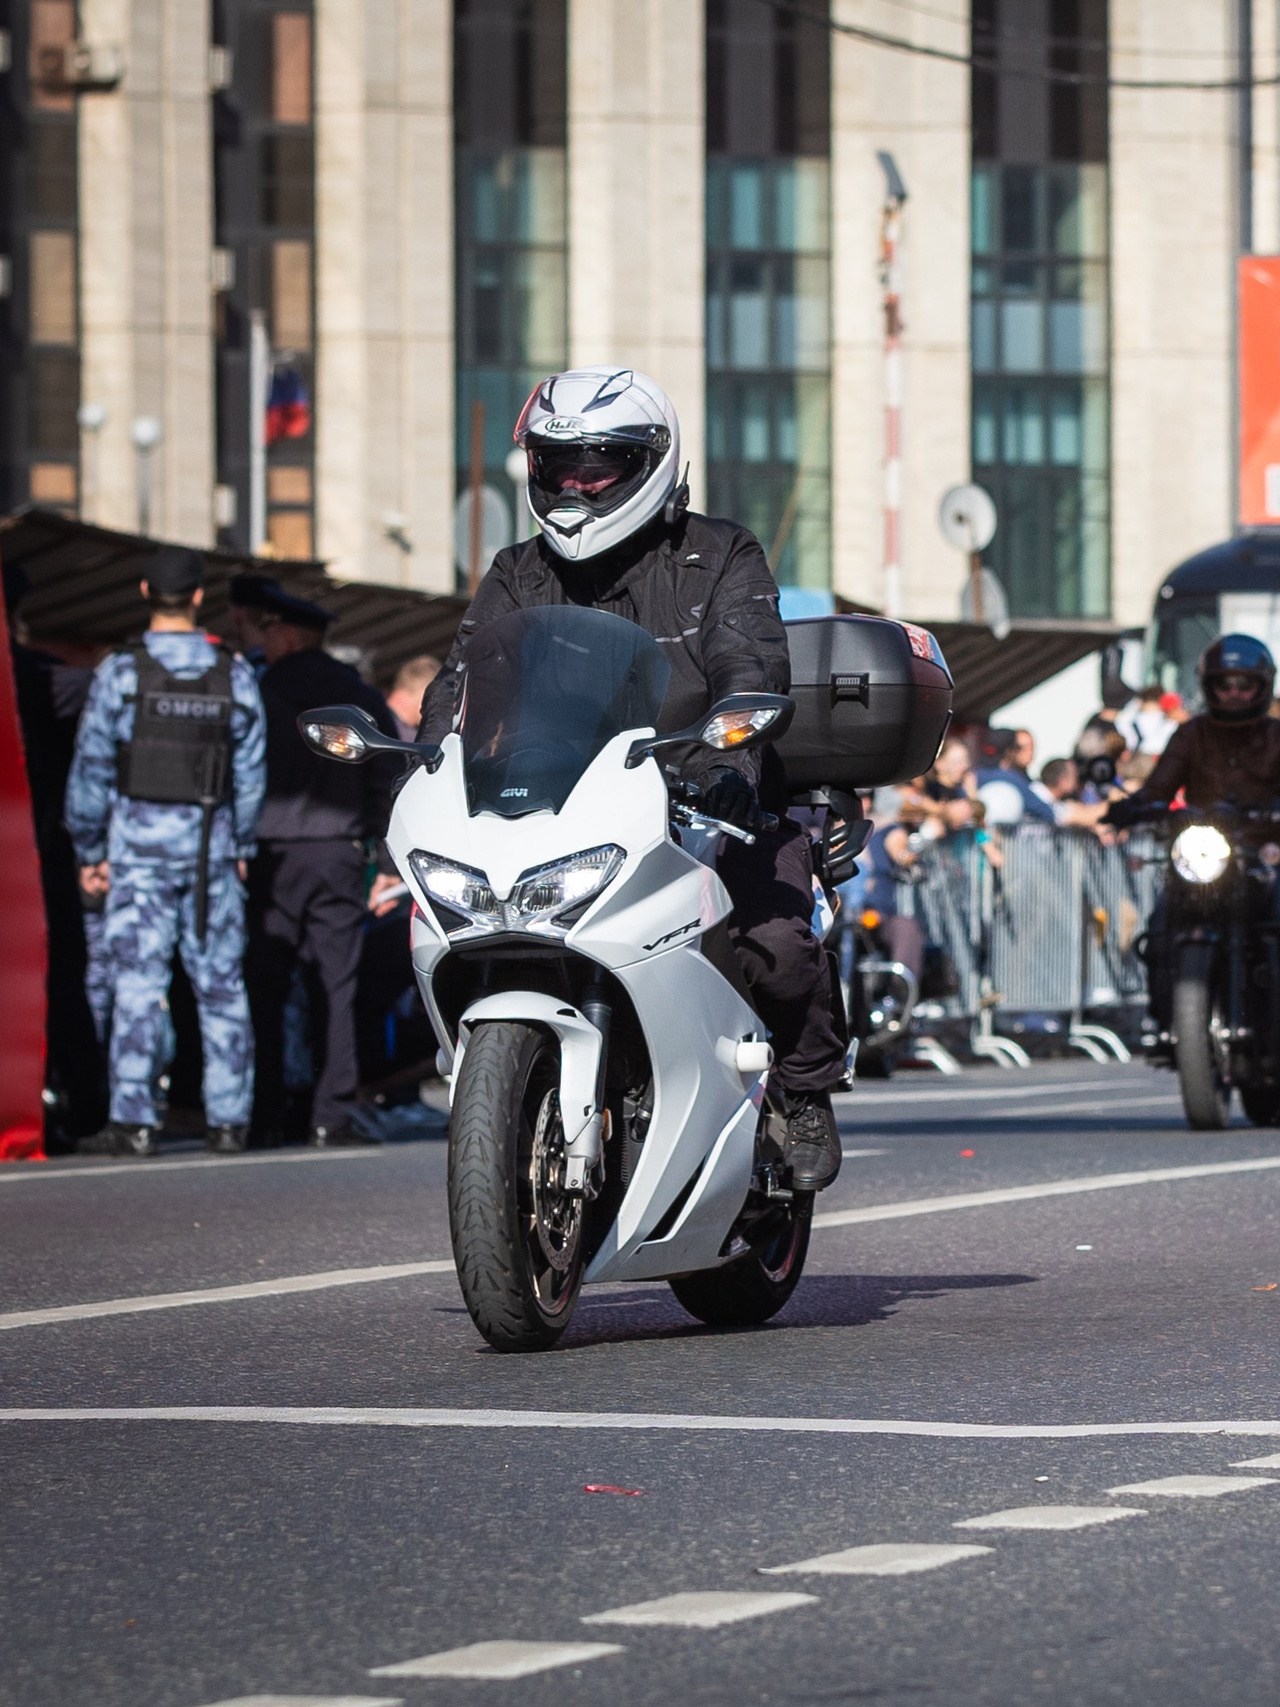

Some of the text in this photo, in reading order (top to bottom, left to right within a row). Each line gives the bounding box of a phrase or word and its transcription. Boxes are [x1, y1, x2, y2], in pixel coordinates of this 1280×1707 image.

[157, 698, 220, 717] ОМОН
[500, 788, 528, 797] GIVI
[642, 917, 702, 951] VFR
